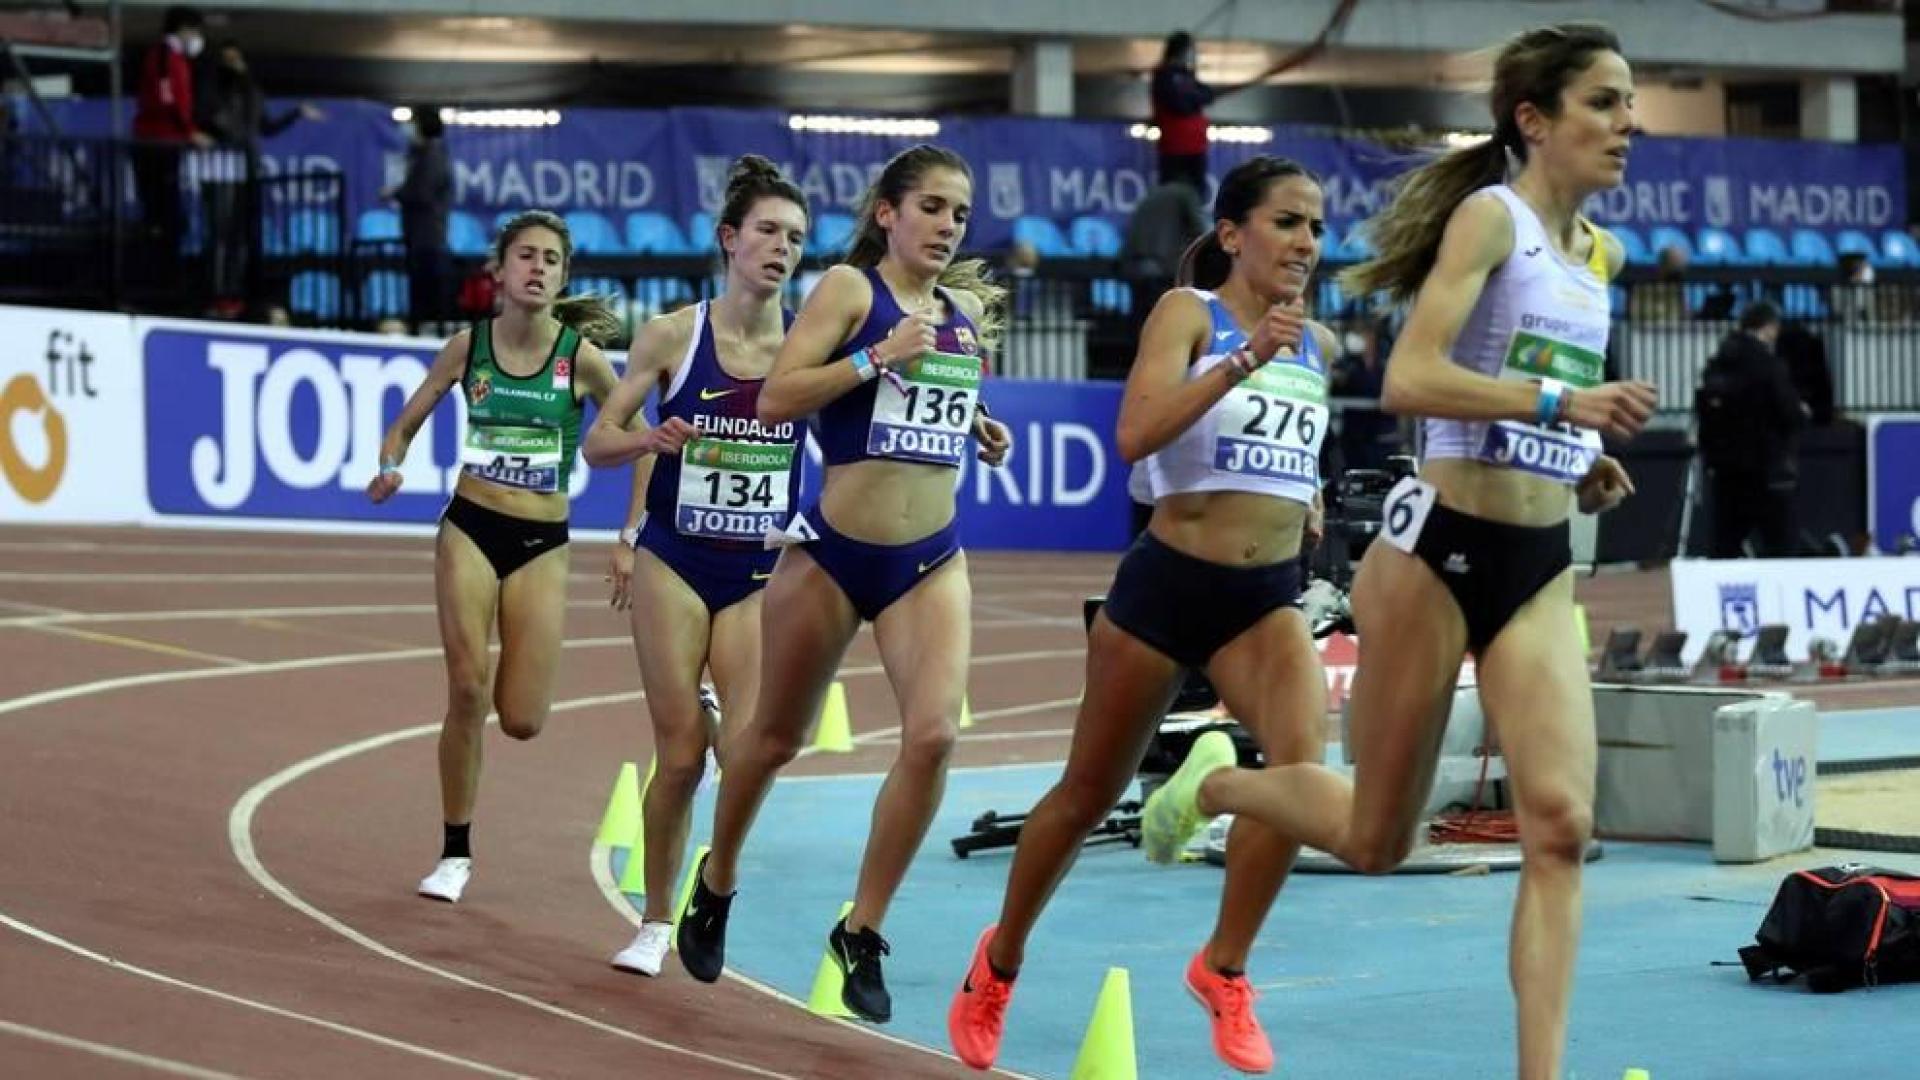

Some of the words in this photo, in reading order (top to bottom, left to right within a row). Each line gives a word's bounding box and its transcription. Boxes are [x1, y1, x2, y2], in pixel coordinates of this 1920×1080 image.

[453, 160, 654, 208] MADRID
[1750, 184, 1891, 225] MADRID
[46, 330, 97, 397] fit
[905, 386, 968, 427] 136
[1242, 395, 1316, 446] 276
[721, 451, 788, 465] IBERDROLA
[704, 471, 773, 508] 134
[1389, 487, 1422, 537] 6
[1771, 748, 1806, 808] tve
